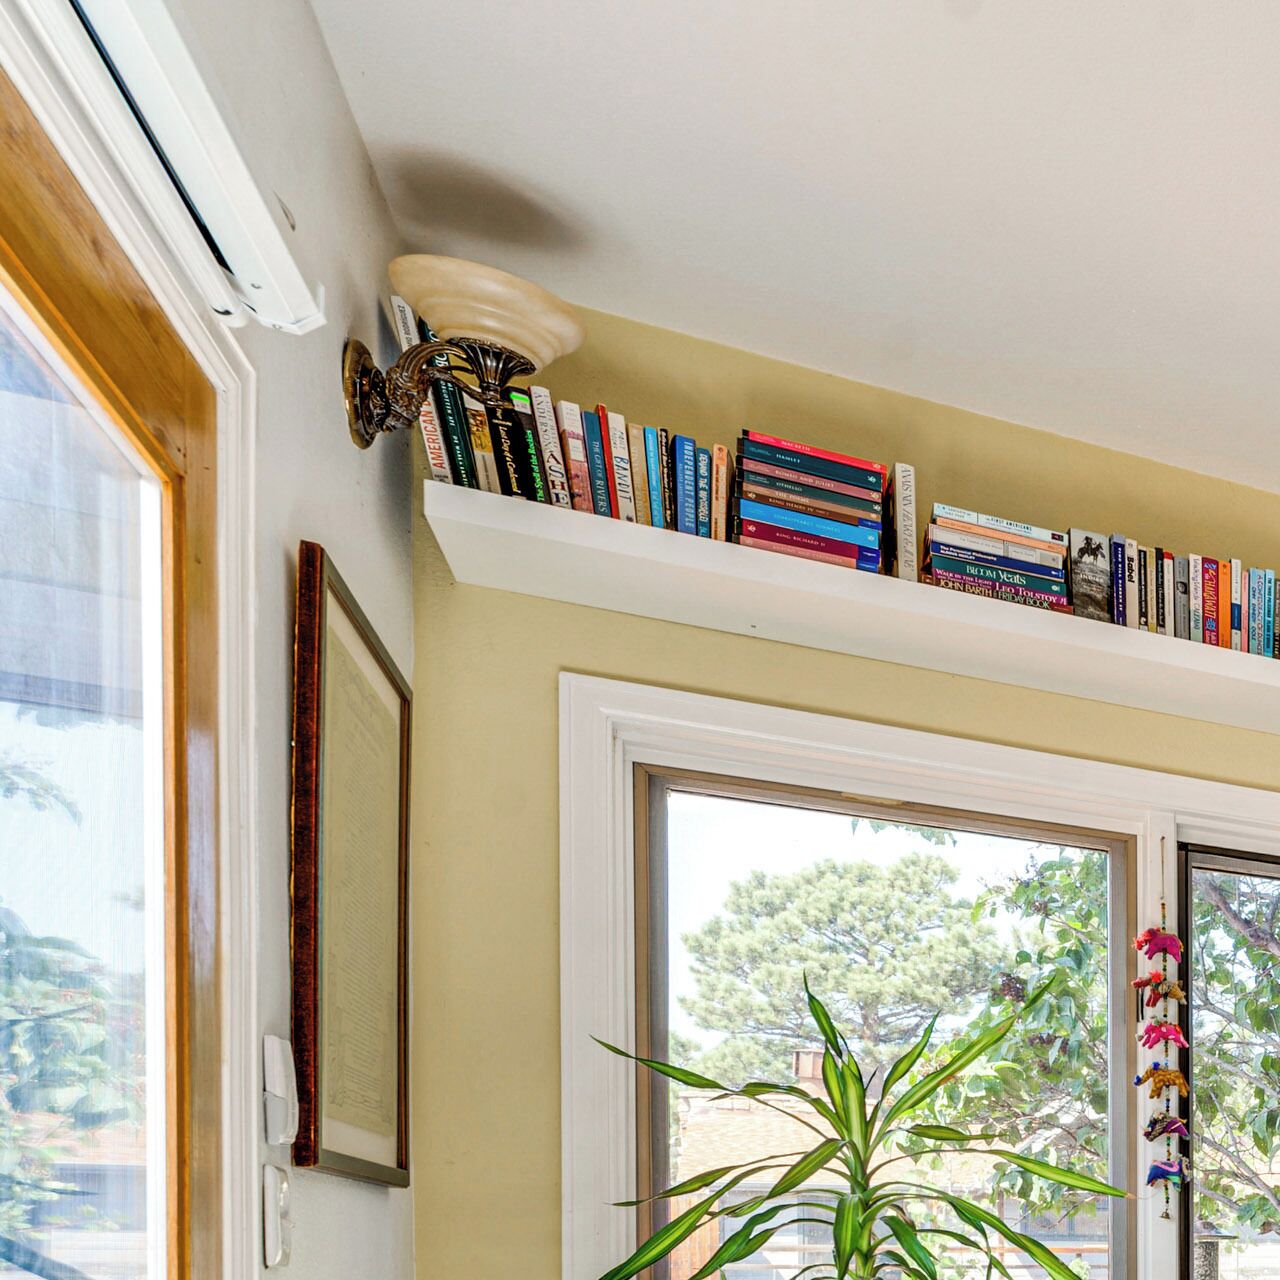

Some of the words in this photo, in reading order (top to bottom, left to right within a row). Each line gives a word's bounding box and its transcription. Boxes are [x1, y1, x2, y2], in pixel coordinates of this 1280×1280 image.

[535, 394, 552, 451] ANDERSON
[422, 410, 446, 469] AMERICAN
[683, 441, 694, 495] INDEPENDENT
[776, 453, 801, 463] HAMLET
[592, 441, 600, 453] THE
[596, 480, 608, 512] RIVERS
[614, 455, 632, 503] BANDIT
[684, 496, 695, 528] PEOPLE
[1006, 520, 1032, 532] AMERICANS
[966, 565, 996, 579] BLOOM
[998, 569, 1027, 585] Yeats
[1126, 555, 1135, 583] Babel
[939, 579, 963, 592] JOHN
[965, 583, 992, 598] BARTH
[998, 591, 1026, 604] FRIDAY
[1026, 597, 1052, 610] BOOK
[995, 582, 1015, 594] LEO
[1016, 586, 1058, 604] TOLSTOY
[1204, 577, 1217, 619] HAKAWATI
